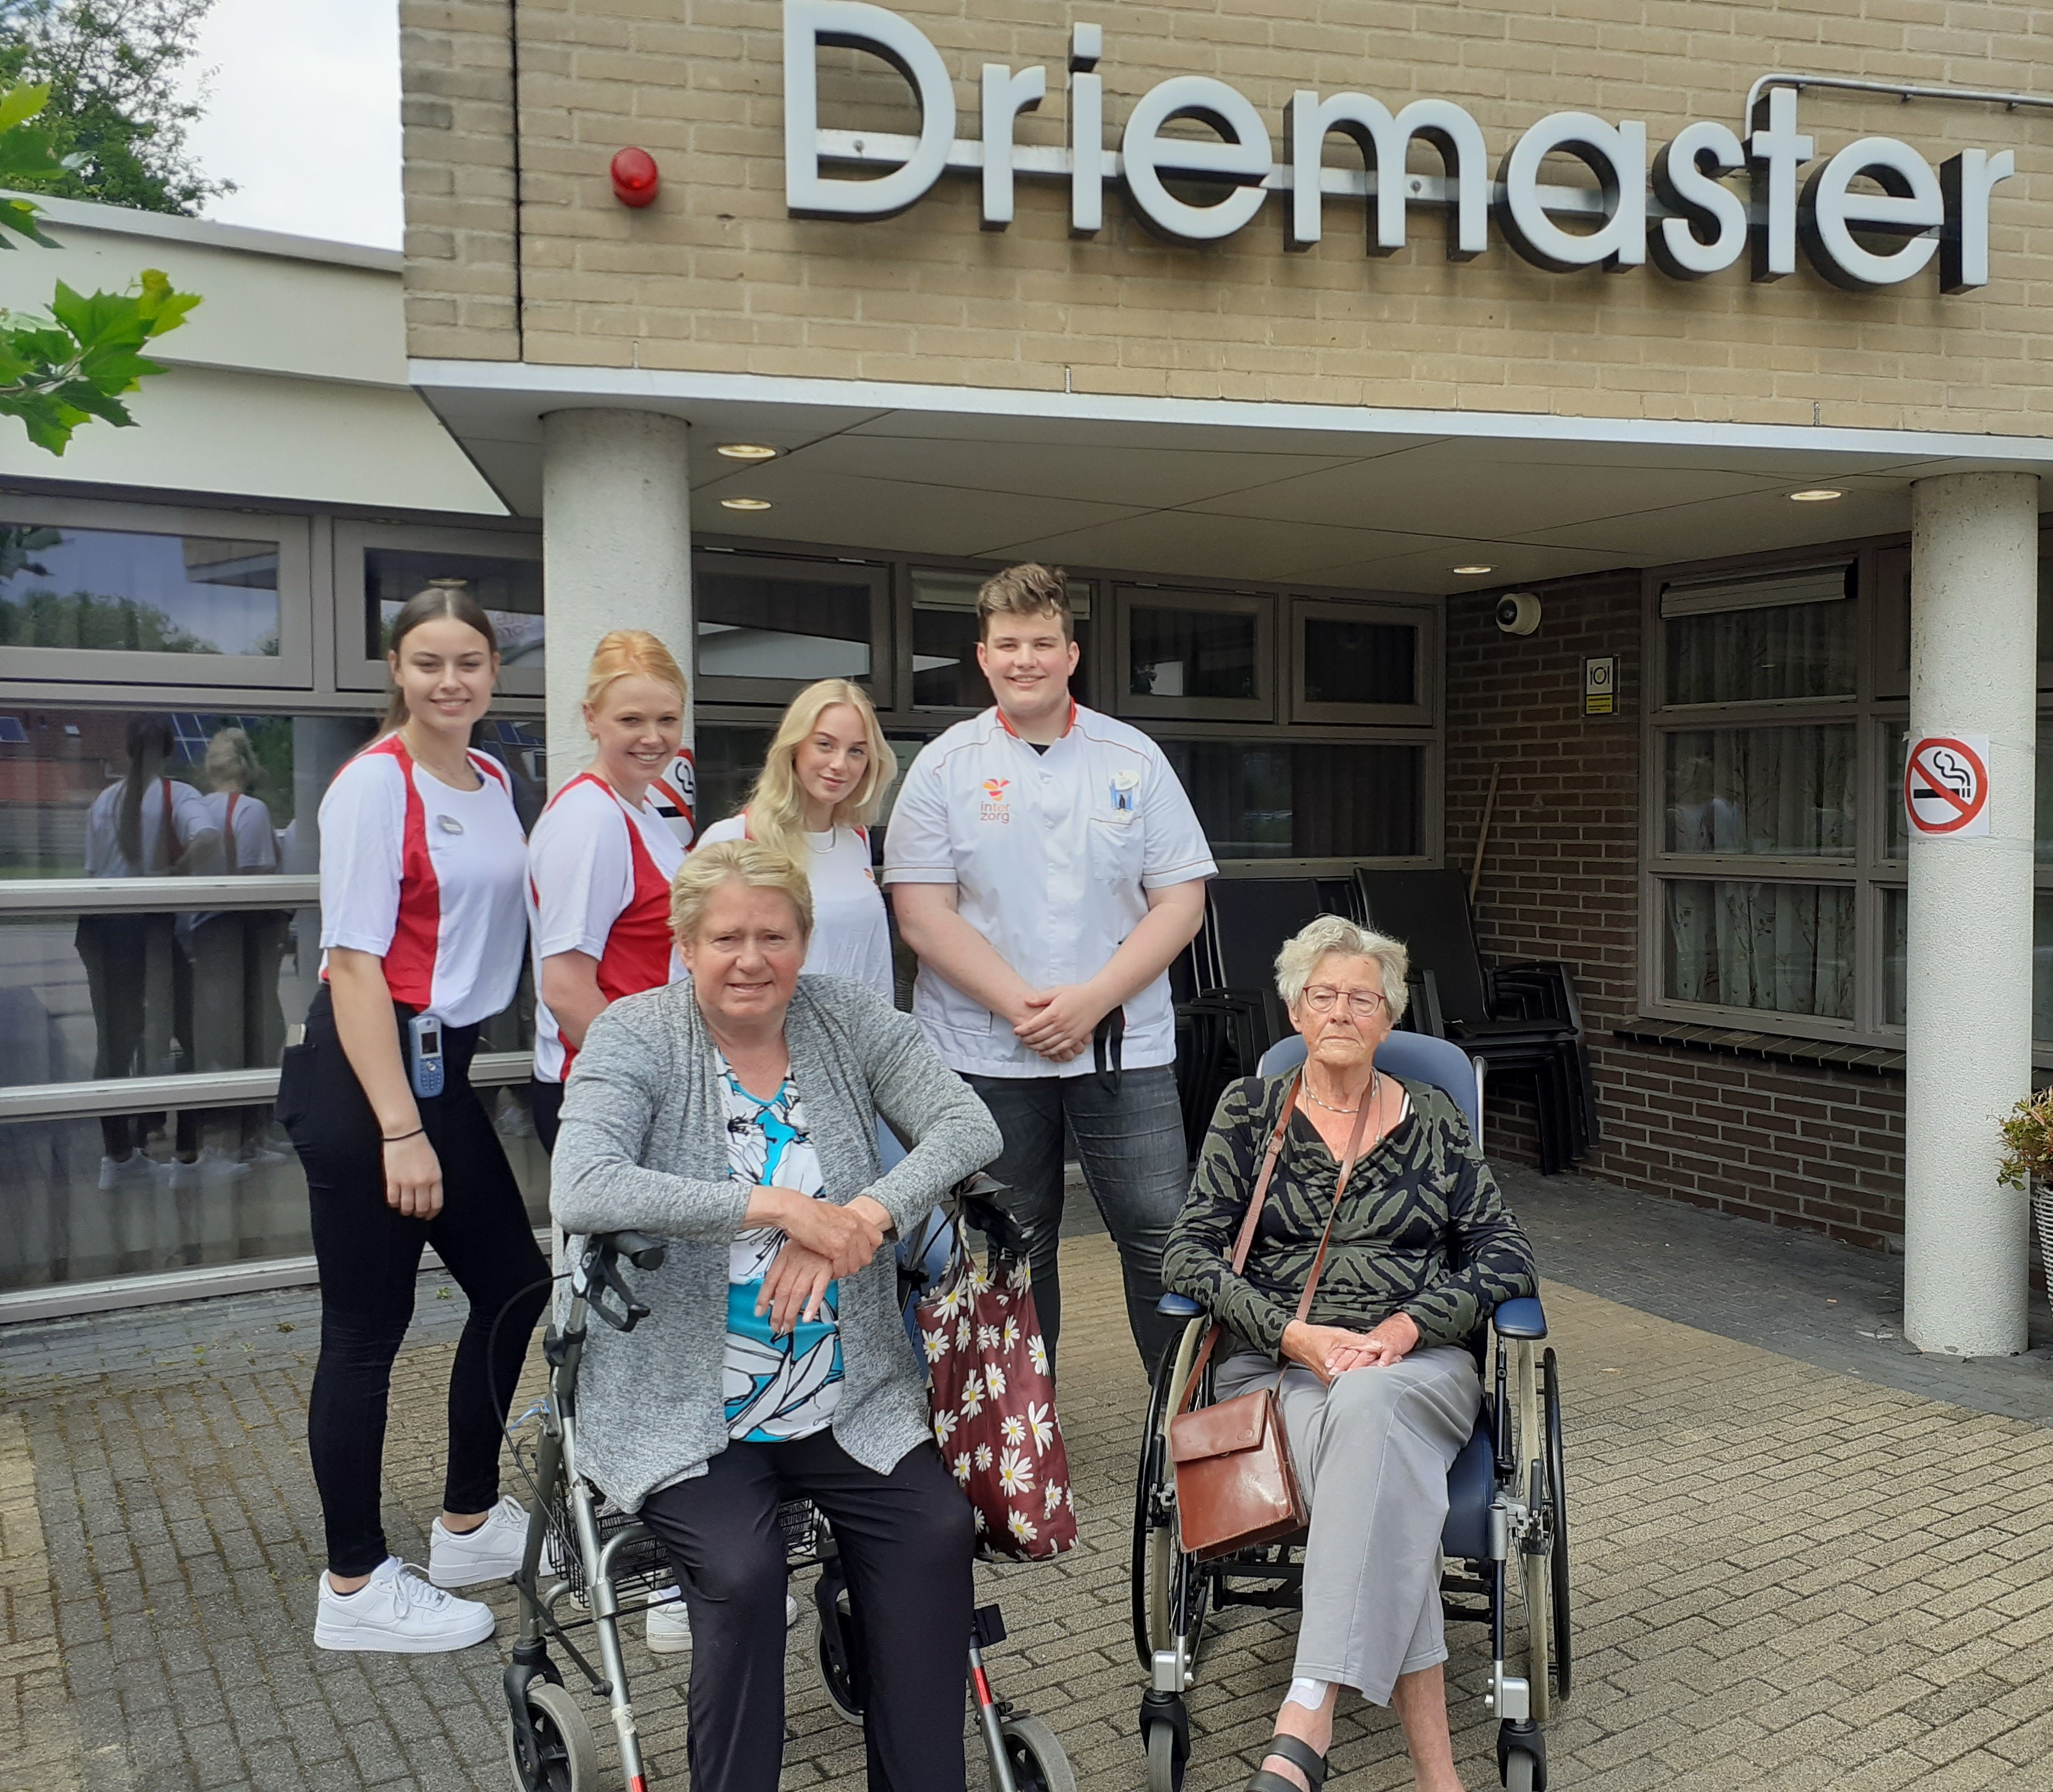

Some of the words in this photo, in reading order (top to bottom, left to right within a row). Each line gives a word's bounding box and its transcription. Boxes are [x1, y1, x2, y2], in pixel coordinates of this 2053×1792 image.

[783, 0, 2015, 290] Driemaster
[980, 801, 1011, 812] inter
[980, 812, 1010, 824] zorg
